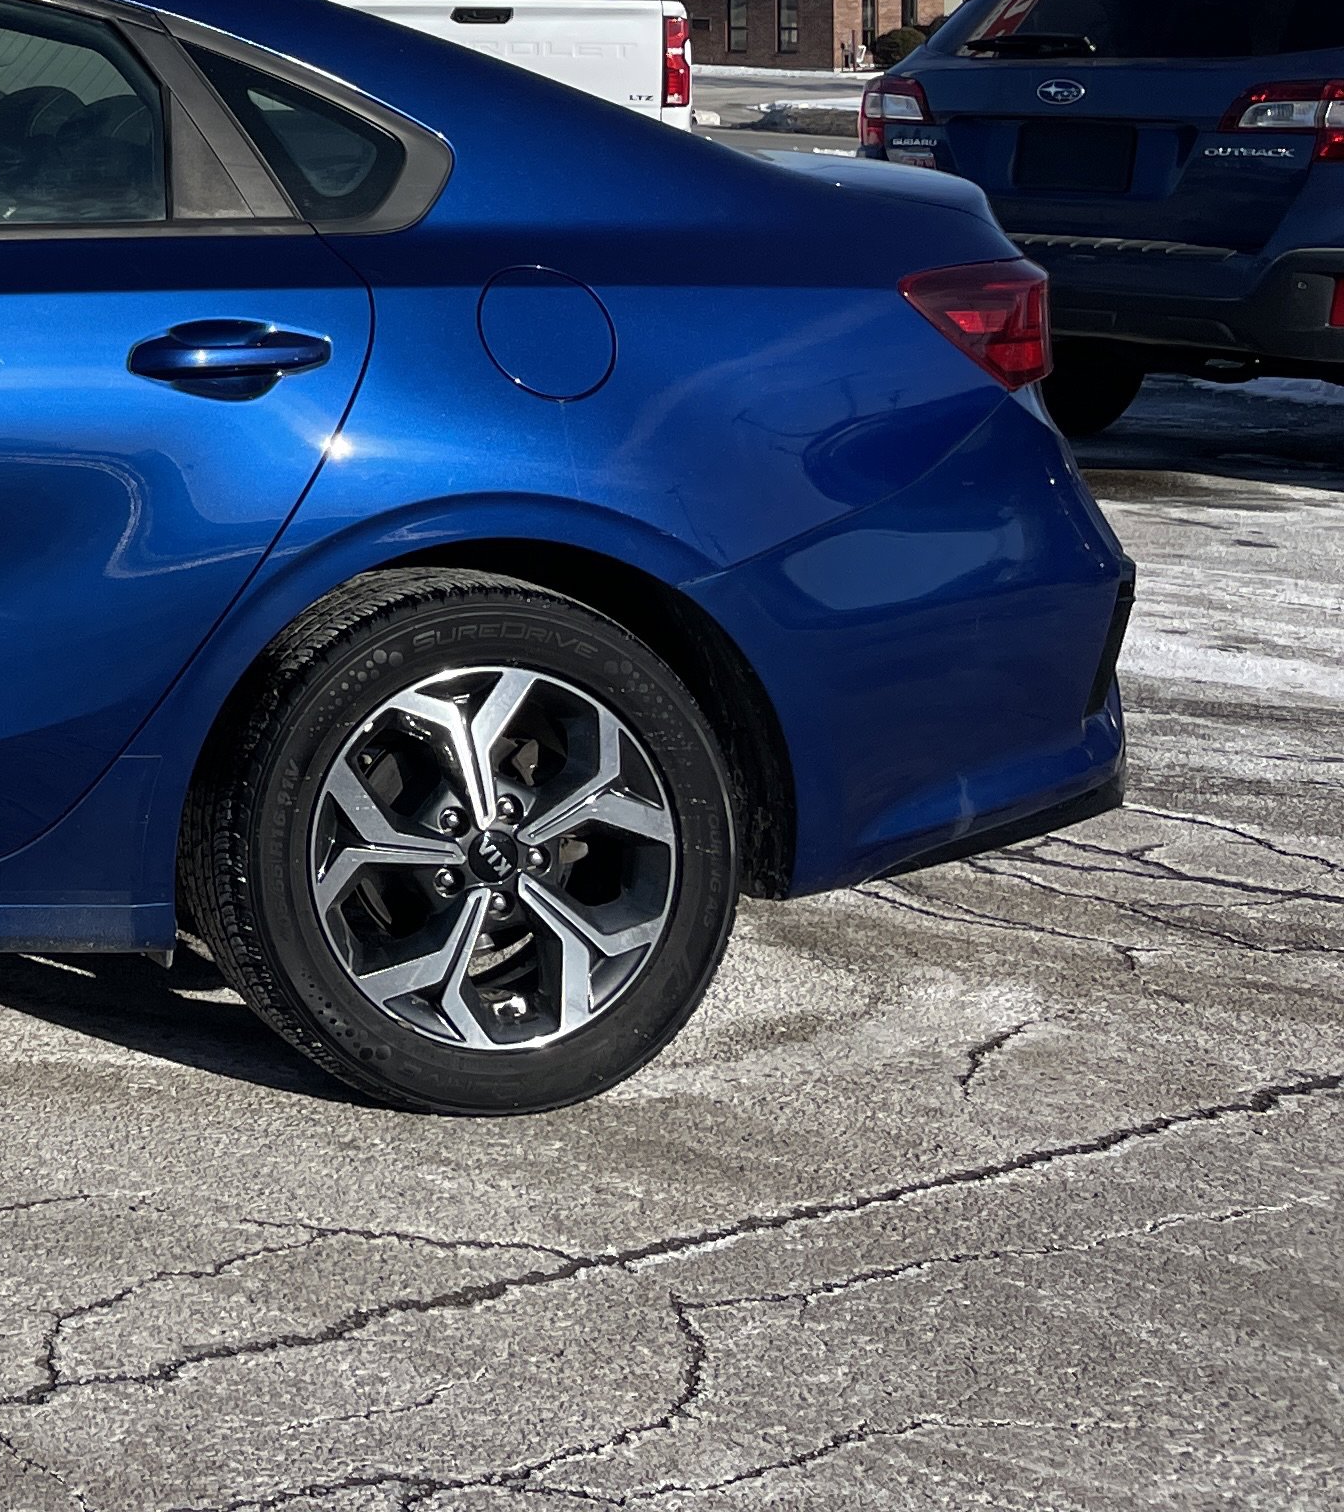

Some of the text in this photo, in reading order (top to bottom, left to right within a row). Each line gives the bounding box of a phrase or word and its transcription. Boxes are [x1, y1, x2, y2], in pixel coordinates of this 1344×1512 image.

[468, 40, 638, 58] ROLET
[892, 137, 938, 146] SUBARU
[1204, 147, 1295, 158] OUTBACK
[478, 834, 512, 878] KIA
